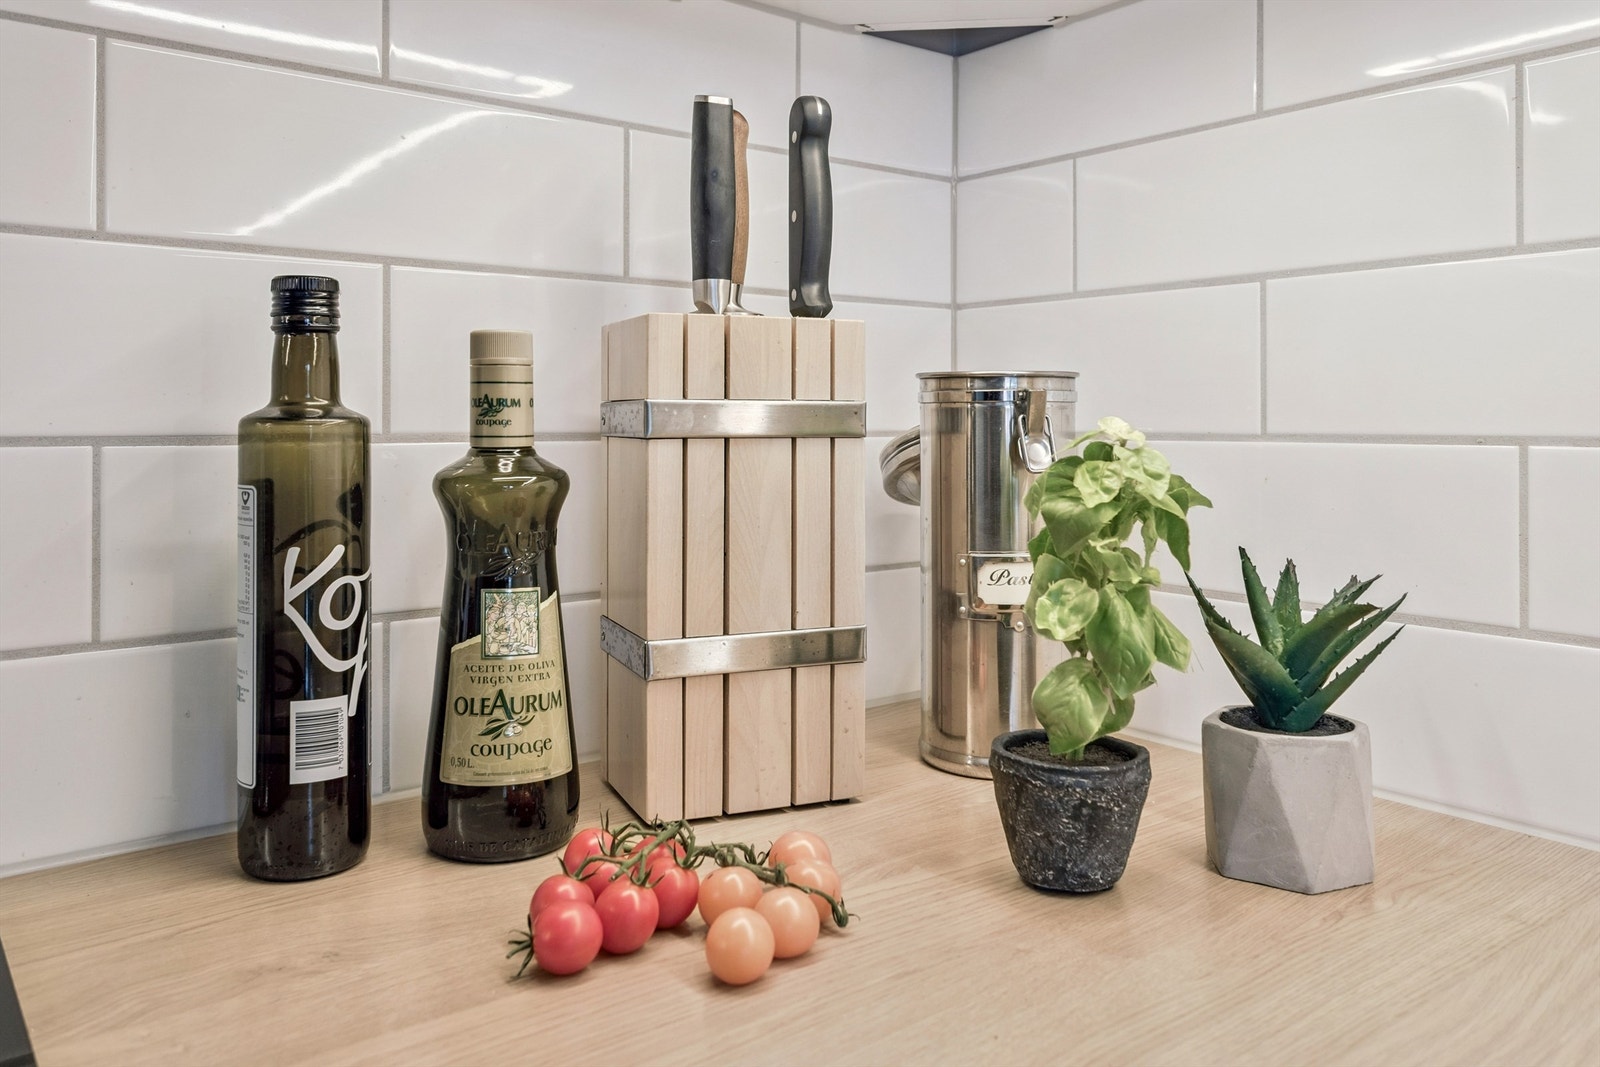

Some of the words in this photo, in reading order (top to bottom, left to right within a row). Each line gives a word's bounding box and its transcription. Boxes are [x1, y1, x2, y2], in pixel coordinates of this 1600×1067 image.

[476, 418, 512, 428] coupage
[463, 664, 505, 673] ACEITE
[509, 662, 525, 672] DE
[528, 659, 556, 670] OLIVA
[470, 674, 514, 687] VIRGEN
[517, 671, 551, 683] EXTRA
[454, 688, 563, 721] OLEAURUM
[470, 737, 553, 760] coupage
[450, 757, 467, 769] 0,50
